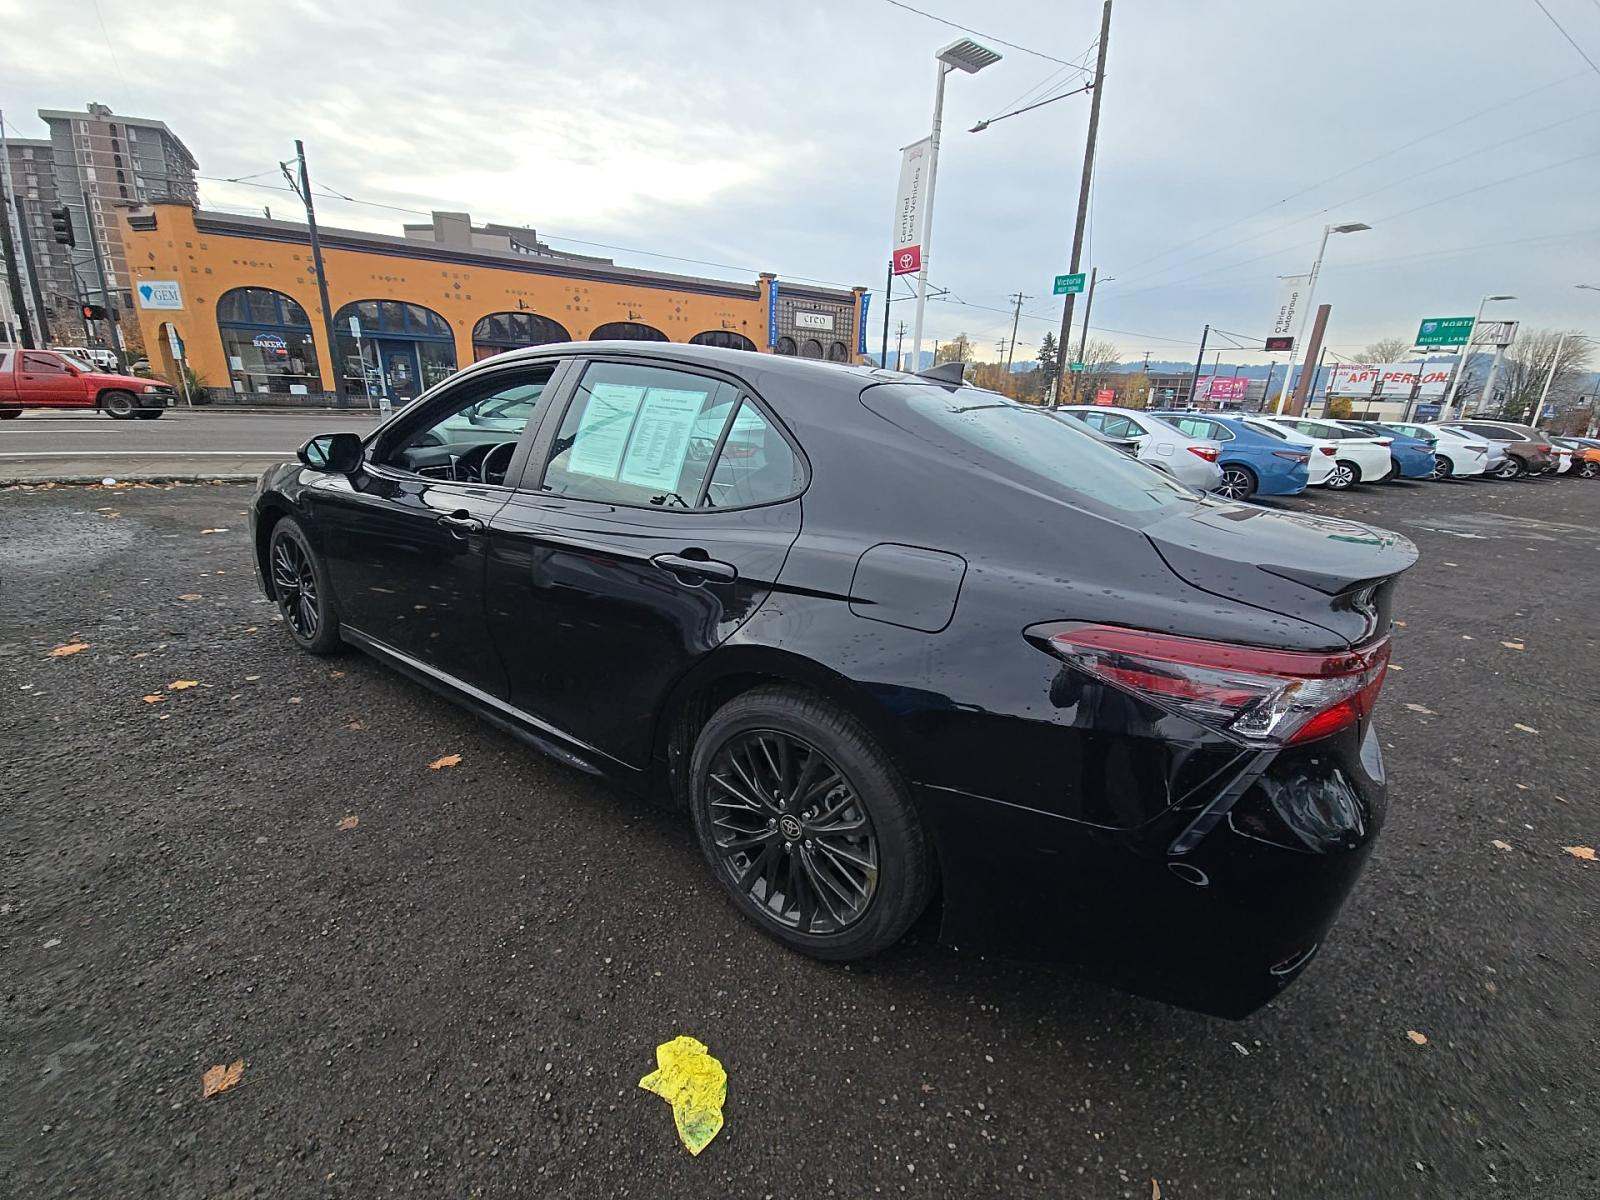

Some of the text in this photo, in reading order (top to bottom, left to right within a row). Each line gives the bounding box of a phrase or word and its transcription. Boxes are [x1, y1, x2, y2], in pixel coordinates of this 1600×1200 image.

[907, 167, 921, 242] Used Vehicles
[901, 197, 910, 243] Certified
[1056, 277, 1081, 286] Victoria
[154, 290, 179, 301] GEM
[1282, 291, 1299, 333] Autogroup
[252, 339, 287, 349] BAKERY
[1347, 371, 1380, 384] ART
